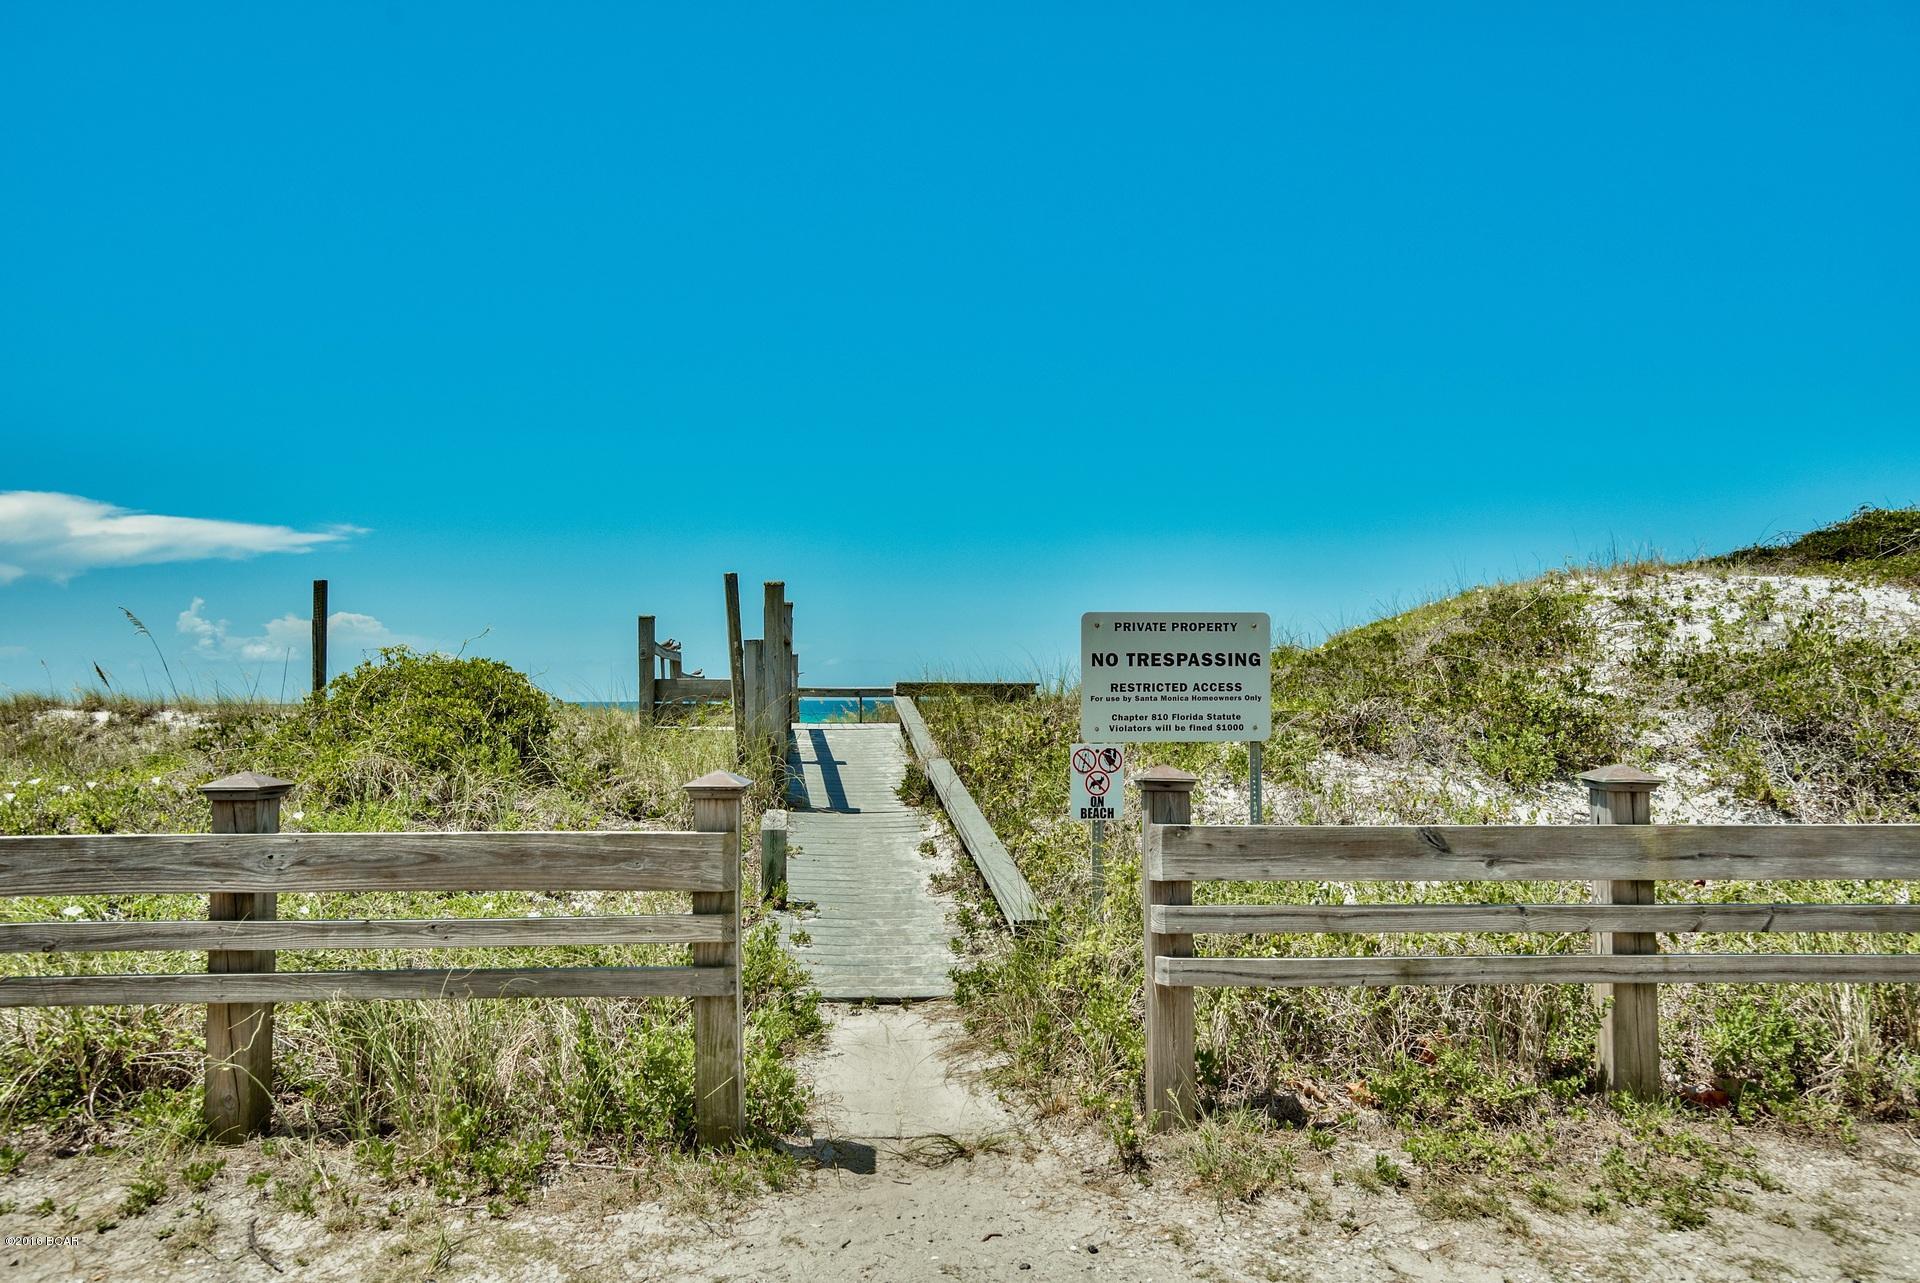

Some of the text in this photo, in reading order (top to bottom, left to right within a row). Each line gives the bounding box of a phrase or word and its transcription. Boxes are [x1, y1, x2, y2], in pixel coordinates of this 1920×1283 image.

[1114, 622, 1238, 632] PRIVATE PROPERTY
[1091, 652, 1262, 667] NO TRESPASSING
[1110, 682, 1243, 692] RESTRICTED ACCESS
[1122, 695, 1132, 703] by
[1244, 695, 1262, 703] Only
[1111, 713, 1242, 723] Chapter 810 Florida Statute
[1109, 723, 1244, 732] Violators will be fined $1000
[1090, 796, 1105, 808] ON
[1080, 807, 1115, 819] BEACH
